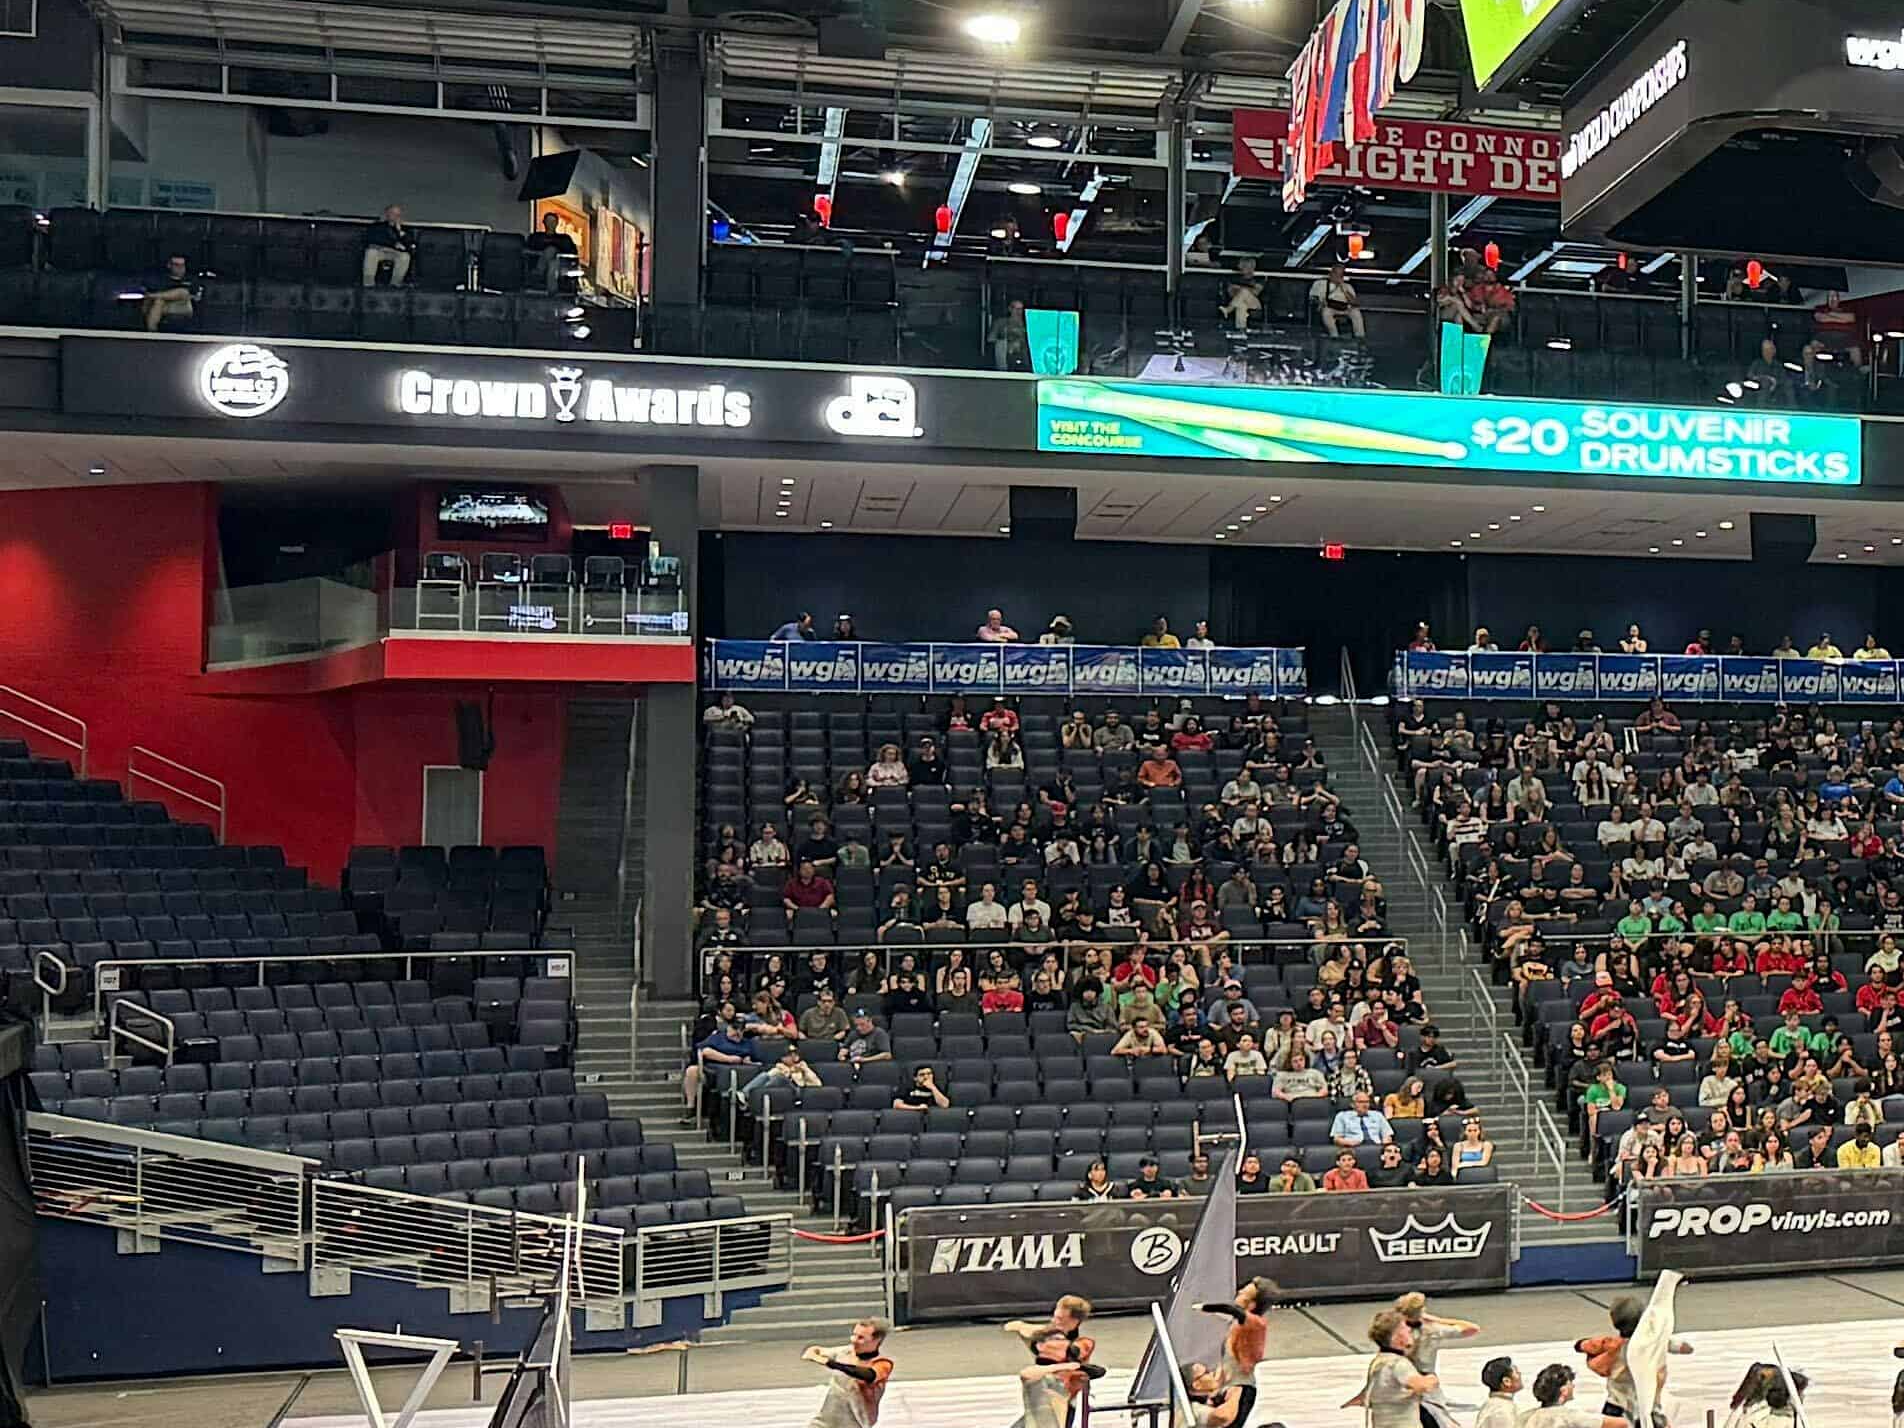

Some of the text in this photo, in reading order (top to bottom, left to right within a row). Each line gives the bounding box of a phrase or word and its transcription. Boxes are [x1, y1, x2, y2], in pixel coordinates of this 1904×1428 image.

[1425, 129, 1562, 159] CONNO
[401, 370, 751, 428] Crown Awards
[1091, 421, 1120, 435] THE
[1471, 409, 1790, 456] $20 SOUVENIR
[1580, 441, 1850, 479] DRUMSTICKS
[960, 1233, 1086, 1271] TAMA
[1387, 1235, 1475, 1256] REMO
